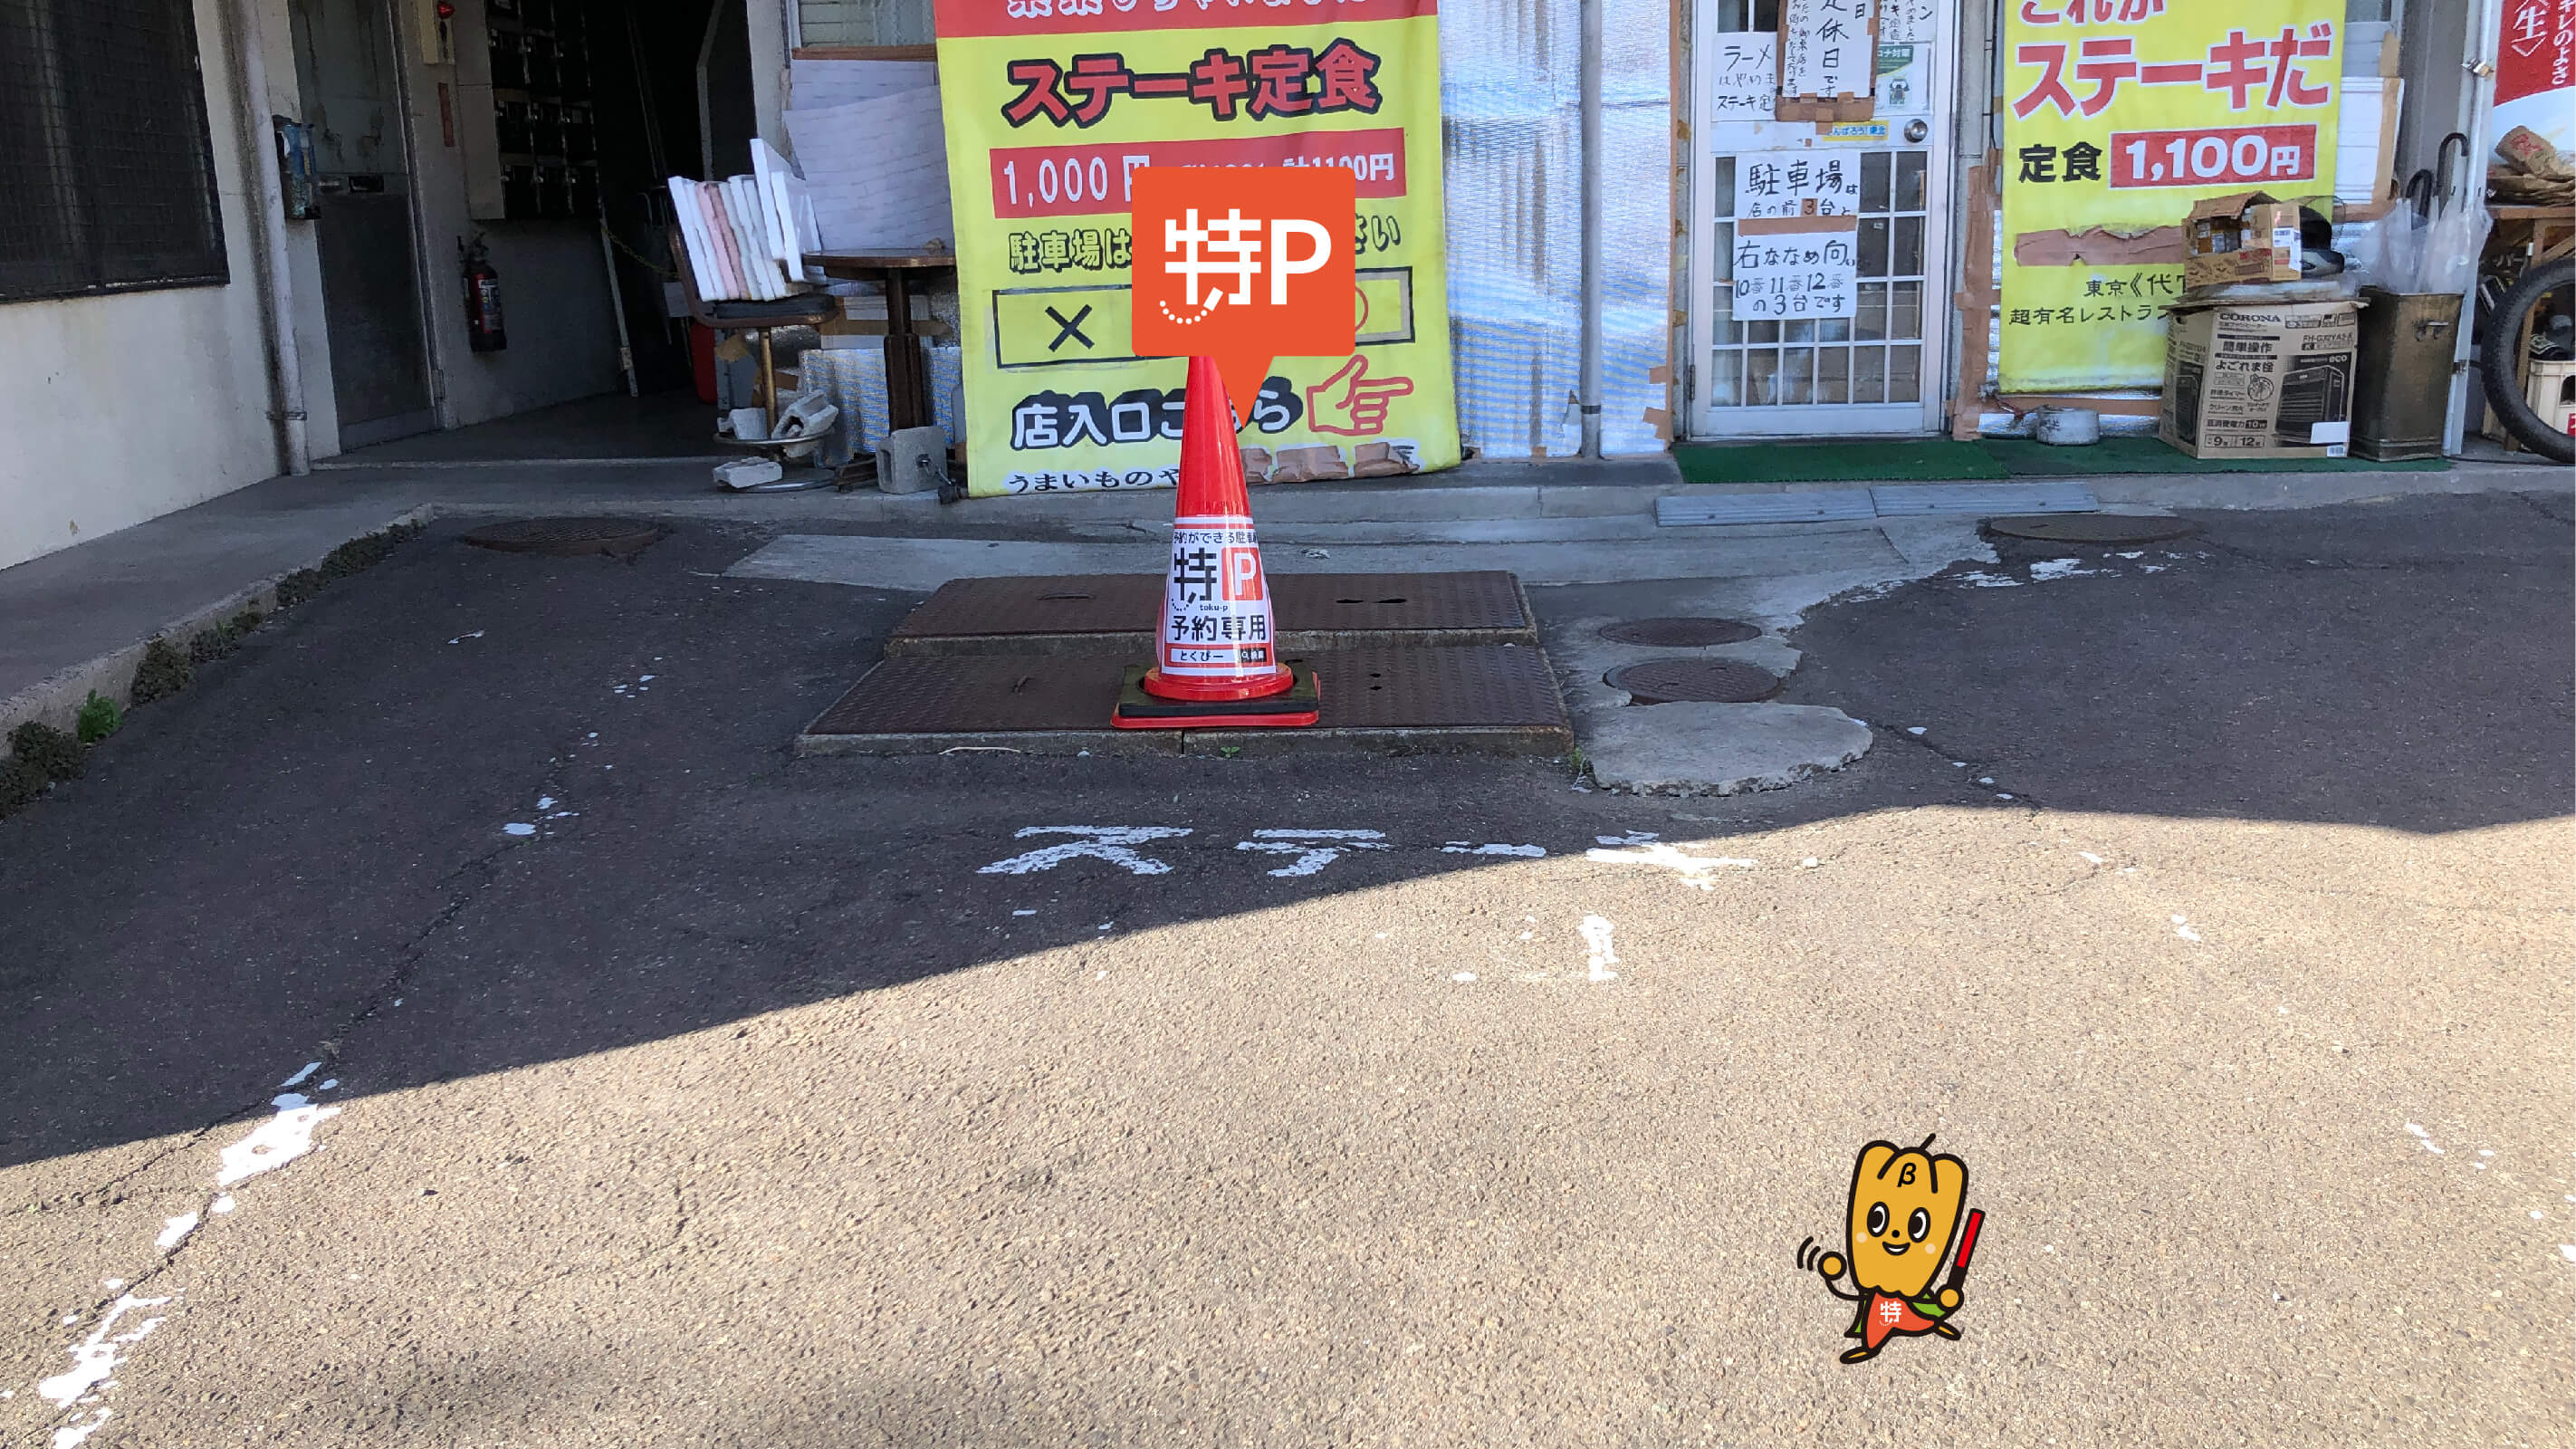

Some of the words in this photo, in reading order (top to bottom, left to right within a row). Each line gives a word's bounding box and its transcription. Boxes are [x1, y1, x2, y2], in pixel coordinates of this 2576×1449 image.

[1001, 38, 1383, 130] ステーキ定食
[2012, 22, 2332, 120] ステーキだ
[1745, 159, 1859, 197] 駐車場は
[2018, 141, 2103, 184] 定食
[2125, 134, 2302, 181] 1,100円
[1009, 229, 1132, 273] 駐車場は
[1753, 293, 1847, 316] の3台です
[2219, 312, 2282, 323] CORONA
[1200, 603, 1229, 612] toku-p
[1171, 615, 1267, 641] 予約専用
